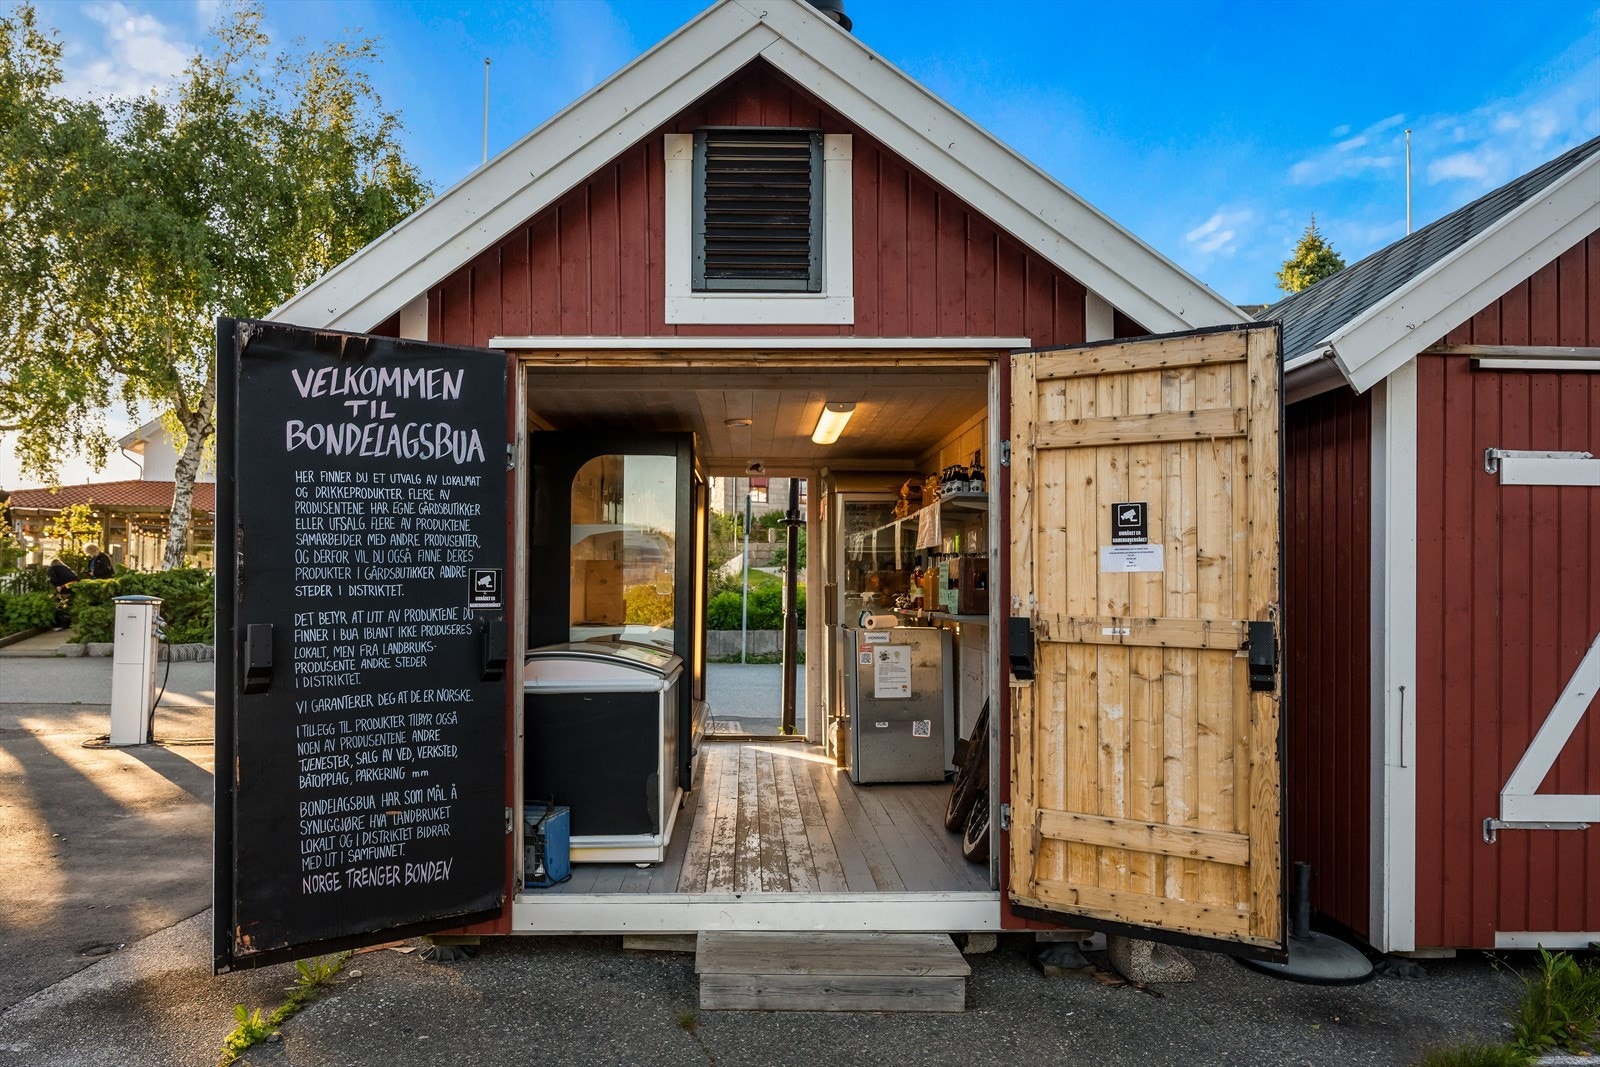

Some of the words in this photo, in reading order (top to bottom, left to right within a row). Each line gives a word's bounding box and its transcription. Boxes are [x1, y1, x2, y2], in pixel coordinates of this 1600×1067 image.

[291, 365, 464, 400] VELKOMMEN
[344, 400, 396, 419] TIL
[286, 420, 486, 464] BONDELAGSBUA
[295, 471, 315, 483] HER
[321, 471, 352, 483] FINNER
[357, 472, 368, 483] DU
[373, 473, 386, 484] ET
[390, 474, 421, 484] UTVALG
[427, 475, 437, 485] AV
[442, 475, 481, 487] LOKALMAT
[296, 487, 308, 498] OG
[409, 488, 435, 500] FLERE
[440, 489, 450, 501] AV
[295, 501, 364, 515] PRODUSENTENE
[371, 502, 389, 514] HAR
[393, 502, 415, 515] EGNE
[418, 501, 481, 515] GÅRDSBUTIKKER
[296, 518, 324, 530] ELLER
[371, 518, 395, 530] FLERE
[401, 517, 412, 530] AV
[416, 519, 470, 531] PRODUKTENE
[296, 534, 363, 546] SAMARBEIDER
[367, 534, 386, 546] MED
[390, 534, 420, 546] ANDRE
[295, 549, 309, 564] OG
[314, 550, 349, 563] DERFOR
[355, 550, 369, 564] VIL
[373, 551, 385, 564] DU
[387, 548, 412, 564] OGSÅ
[418, 550, 442, 562] FINNE
[447, 550, 474, 563] DERES
[295, 567, 352, 581] PRODUKTER
[357, 567, 360, 579] I
[364, 565, 435, 580] GÅRDSBUTIKKER
[295, 585, 332, 597] STEDER
[339, 585, 341, 596] I
[295, 612, 314, 626] DET
[319, 611, 348, 625] BETYR
[352, 611, 365, 623] AT
[388, 609, 400, 623] AV
[404, 607, 459, 623] PRODUKTENE
[463, 607, 474, 621] DU
[294, 628, 329, 642] FINNER
[333, 629, 335, 640] I
[340, 628, 359, 640] BUA
[364, 626, 394, 640] IBLANT
[398, 625, 417, 638] IKKE
[421, 624, 473, 637] PRODUSERES
[294, 646, 329, 659] LOKALT,
[334, 645, 354, 657] MEN
[360, 643, 379, 656] FRA
[383, 641, 437, 655] LANDBRUKS-
[295, 659, 356, 674] PRODUSENTE
[361, 658, 391, 669] ANDRE
[395, 656, 427, 668] STEDER
[296, 678, 299, 688] I
[296, 701, 308, 714] VI
[311, 694, 374, 714] GARANTERER
[378, 692, 396, 706] DEG
[398, 691, 408, 704] AT
[411, 690, 422, 703] DE
[424, 689, 435, 702] ER
[437, 688, 474, 702] NORSKE.
[296, 726, 299, 738] I
[301, 723, 335, 737] TILLEGG
[339, 721, 352, 734] TIL
[356, 715, 405, 732] PRODUKTER
[408, 713, 432, 726] TILBYR
[436, 711, 458, 725] OGSÅ
[297, 741, 320, 756] NOEN
[324, 739, 336, 752] AV
[340, 732, 407, 750] PRODUSENTENE
[412, 729, 441, 742] ANDRE
[298, 755, 353, 772] TJENESTER,
[356, 750, 378, 764] SALG
[382, 748, 392, 762] AV
[396, 747, 415, 762] VED,
[356, 767, 406, 782] PARKERING
[300, 795, 376, 818] BONDELAGSBUA
[381, 792, 401, 807] HAR
[404, 789, 423, 804] SOM
[427, 785, 447, 802] MÅL
[451, 783, 458, 799] Å
[301, 815, 365, 835] SYNLIGGJØRE
[370, 814, 387, 828] HVA
[394, 806, 451, 825] LANDBRUKET
[301, 836, 336, 854] LOKALT
[340, 834, 352, 847] OG
[356, 833, 359, 846] I
[363, 827, 413, 845] DISTRIKTET
[417, 824, 451, 839] BIDRAR
[302, 856, 322, 871] MED
[325, 852, 337, 867] UT
[341, 851, 343, 864] I
[348, 843, 406, 862] SAMFUNNET.
[302, 872, 342, 895] NORGE
[346, 865, 401, 889] TRENGER
[405, 857, 453, 886] BONDEN
